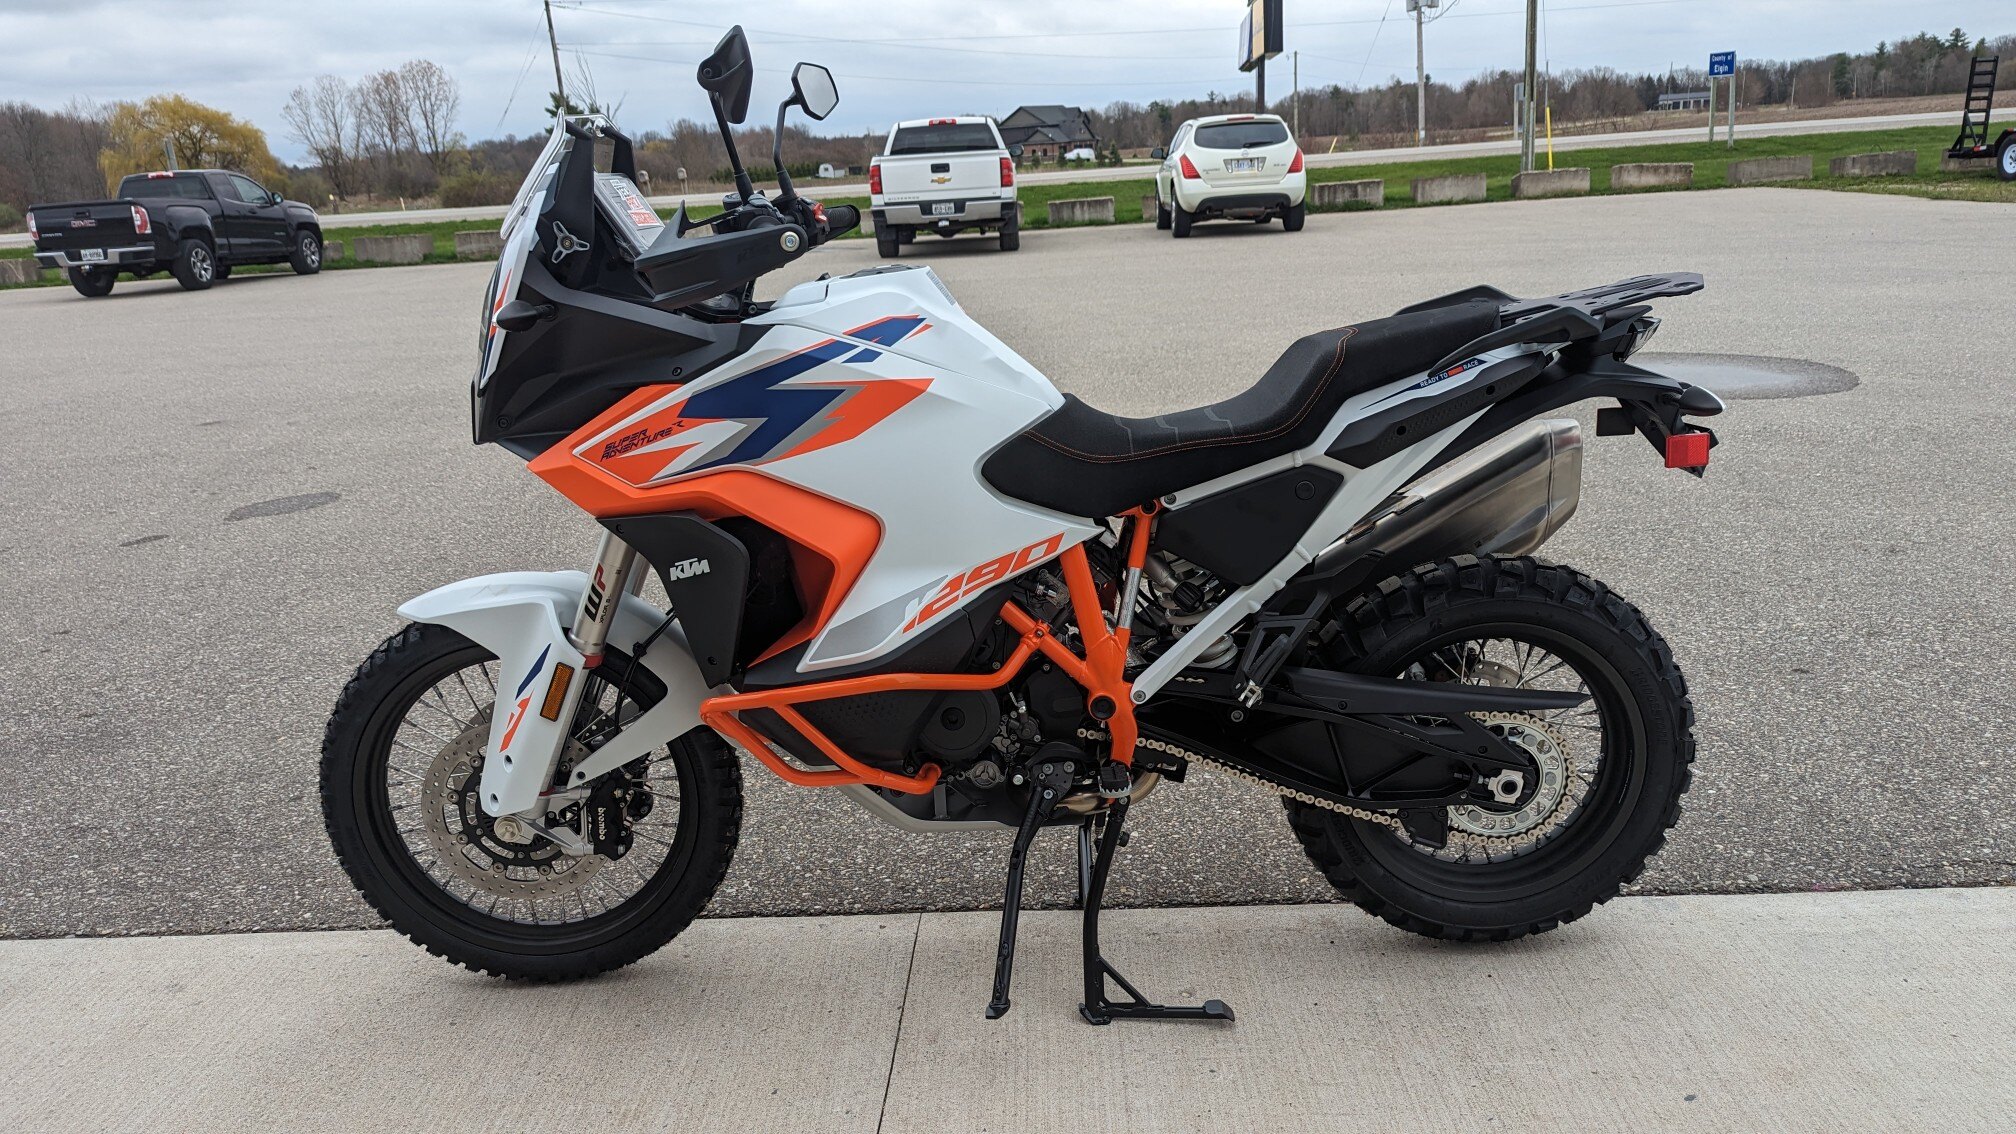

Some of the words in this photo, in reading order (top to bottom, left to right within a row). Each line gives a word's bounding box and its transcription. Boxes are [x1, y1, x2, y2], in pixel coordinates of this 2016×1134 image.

[1714, 64, 1729, 74] Elgin
[70, 219, 96, 228] GMC
[1420, 376, 1439, 387] READY
[1440, 372, 1448, 380] TO
[1463, 360, 1478, 370] RACE
[600, 427, 673, 462] ADVENTURE
[605, 428, 648, 452] SUPER
[669, 557, 711, 581] KTM
[901, 531, 1066, 634] 1290
[597, 807, 607, 840] brembo
